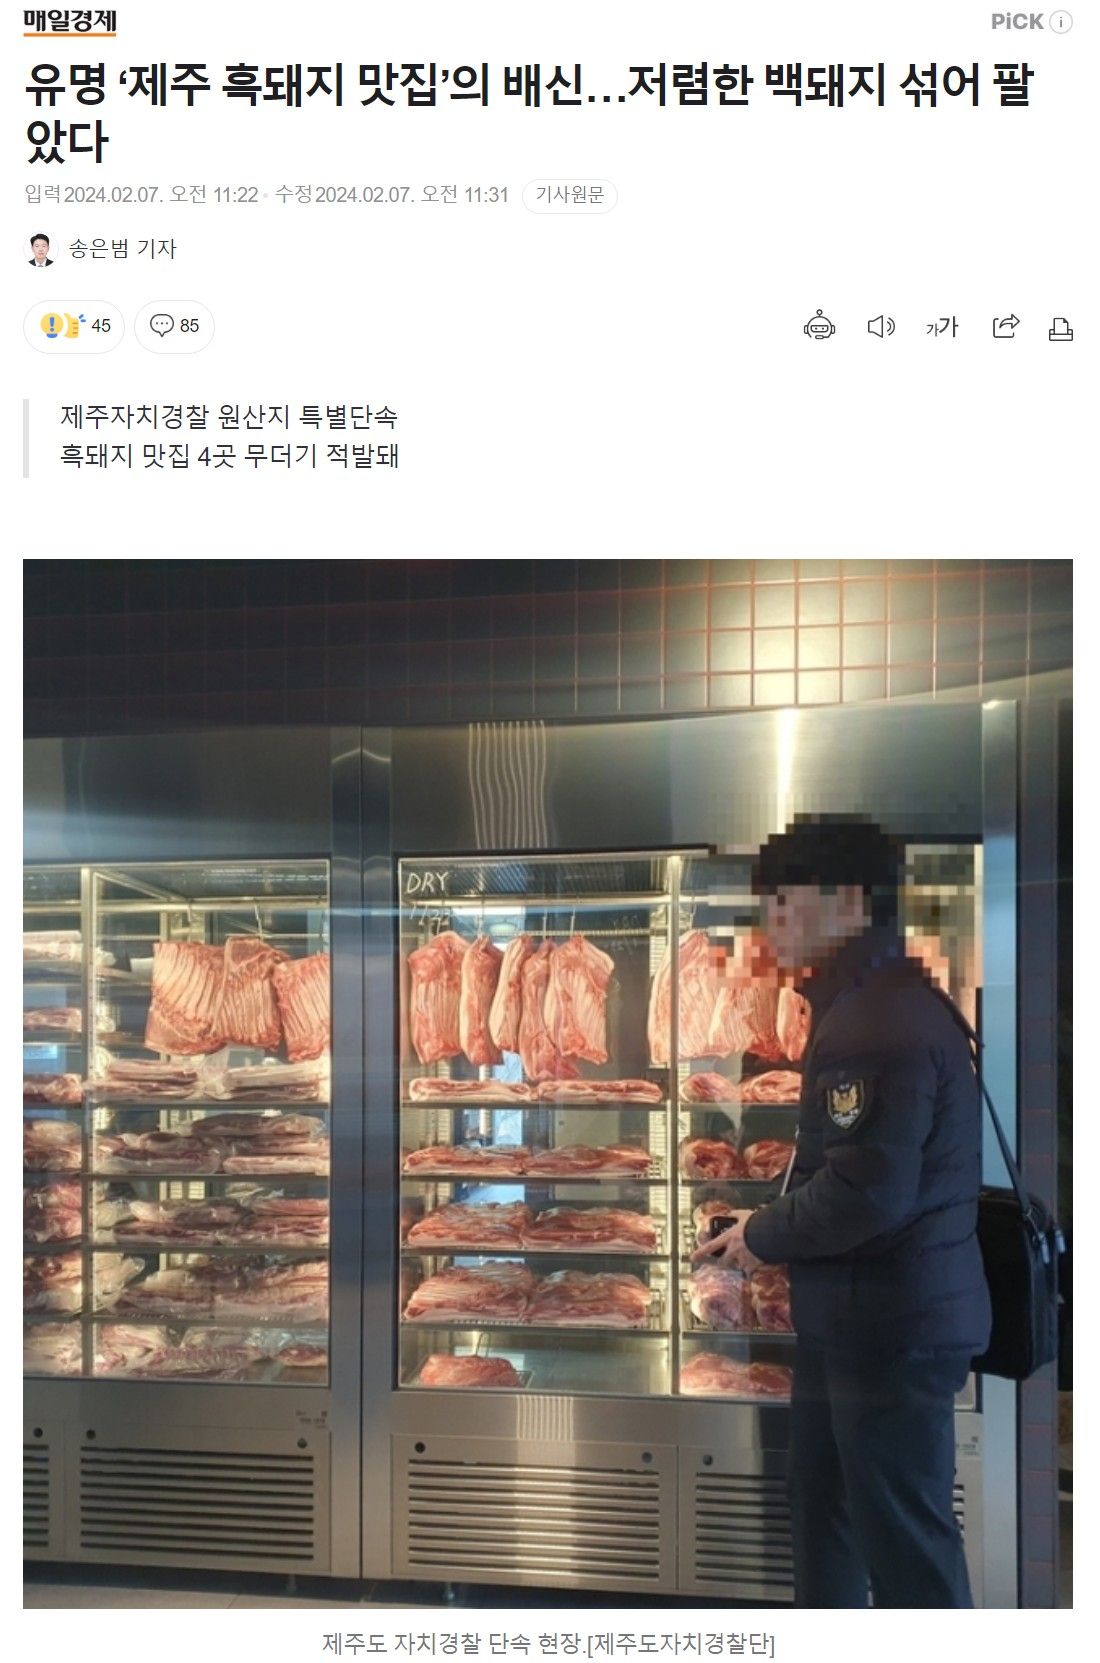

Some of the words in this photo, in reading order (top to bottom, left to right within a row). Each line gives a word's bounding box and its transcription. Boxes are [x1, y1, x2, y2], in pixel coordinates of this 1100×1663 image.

[23, 10, 117, 33] 매일경제
[991, 12, 1045, 30] PiCK
[25, 62, 106, 107] 유명
[119, 62, 211, 107] ‘제주
[221, 62, 343, 108] 흑돼지
[358, 62, 489, 107] 맛집’의
[765, 62, 885, 108] 백돼지
[898, 62, 979, 108] 섞어
[992, 62, 1035, 107] 팔
[26, 119, 110, 165] 았다
[169, 184, 206, 204] 오전
[214, 186, 259, 203] 11:22
[420, 184, 457, 204] 오전
[465, 186, 508, 203] 11:31
[536, 185, 605, 204] 기사원문
[68, 238, 128, 259] 송은범
[137, 238, 178, 260] 기자
[91, 318, 112, 333] 45
[179, 318, 200, 333] 85
[60, 404, 210, 430] 제주자치경찰
[217, 404, 289, 430] 원산지
[298, 404, 398, 430] 특별단속
[60, 443, 132, 469] 흑돼지
[143, 443, 189, 469] 맛집
[197, 443, 237, 469] 4곳
[244, 443, 316, 469] 무더기
[326, 443, 399, 469] 적발돼
[406, 872, 448, 893] DRY
